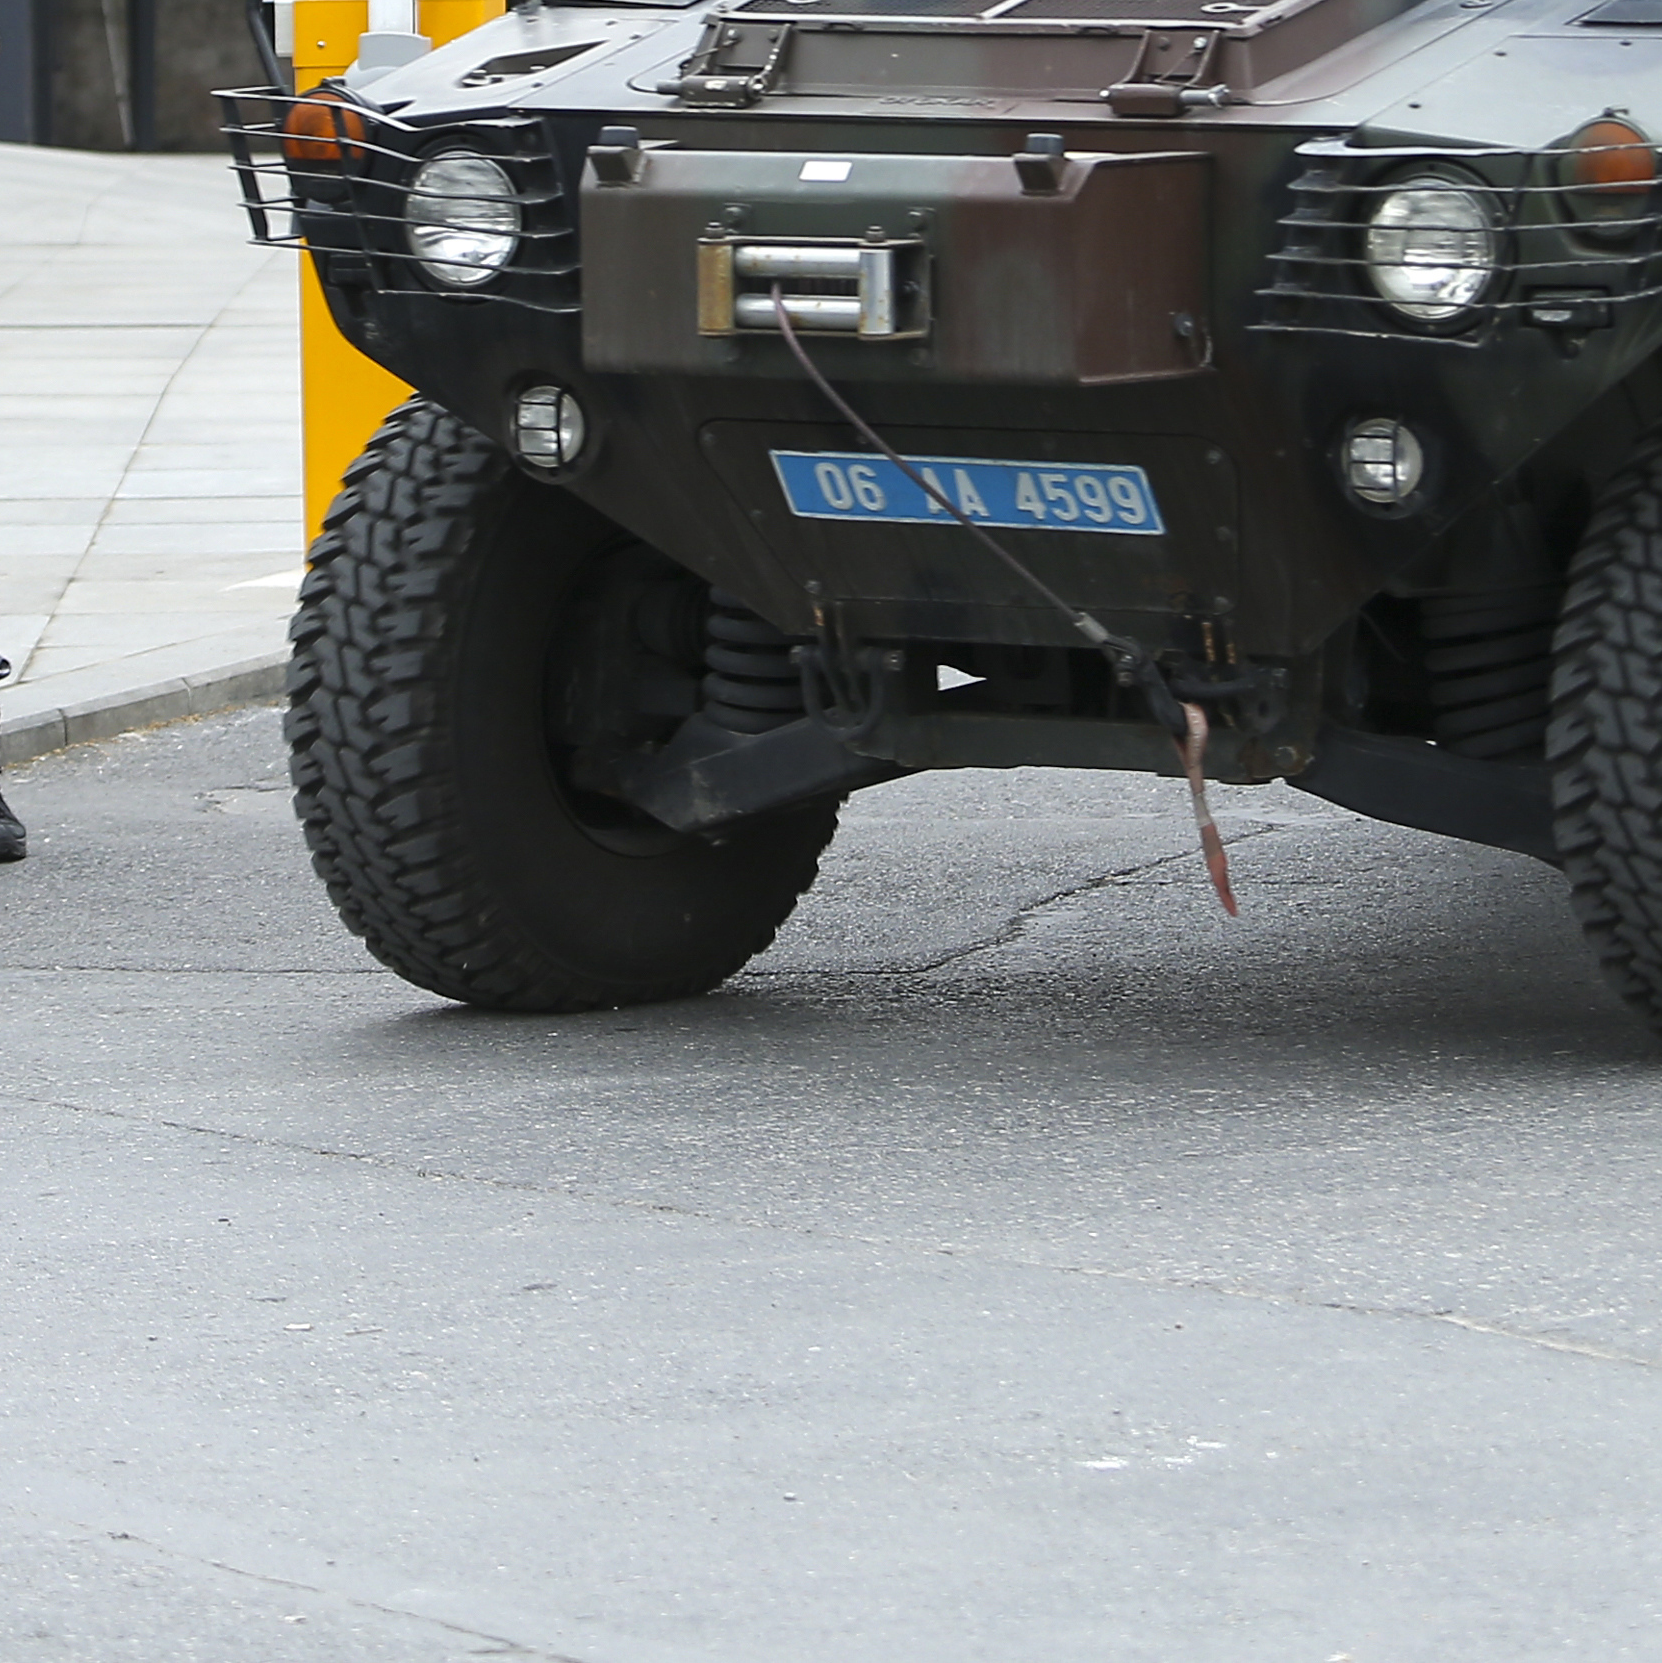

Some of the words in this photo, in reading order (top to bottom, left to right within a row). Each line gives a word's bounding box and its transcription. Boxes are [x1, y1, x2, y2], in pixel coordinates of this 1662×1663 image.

[815, 461, 887, 512] 06
[921, 466, 990, 518] AA
[1015, 471, 1147, 525] 4599
